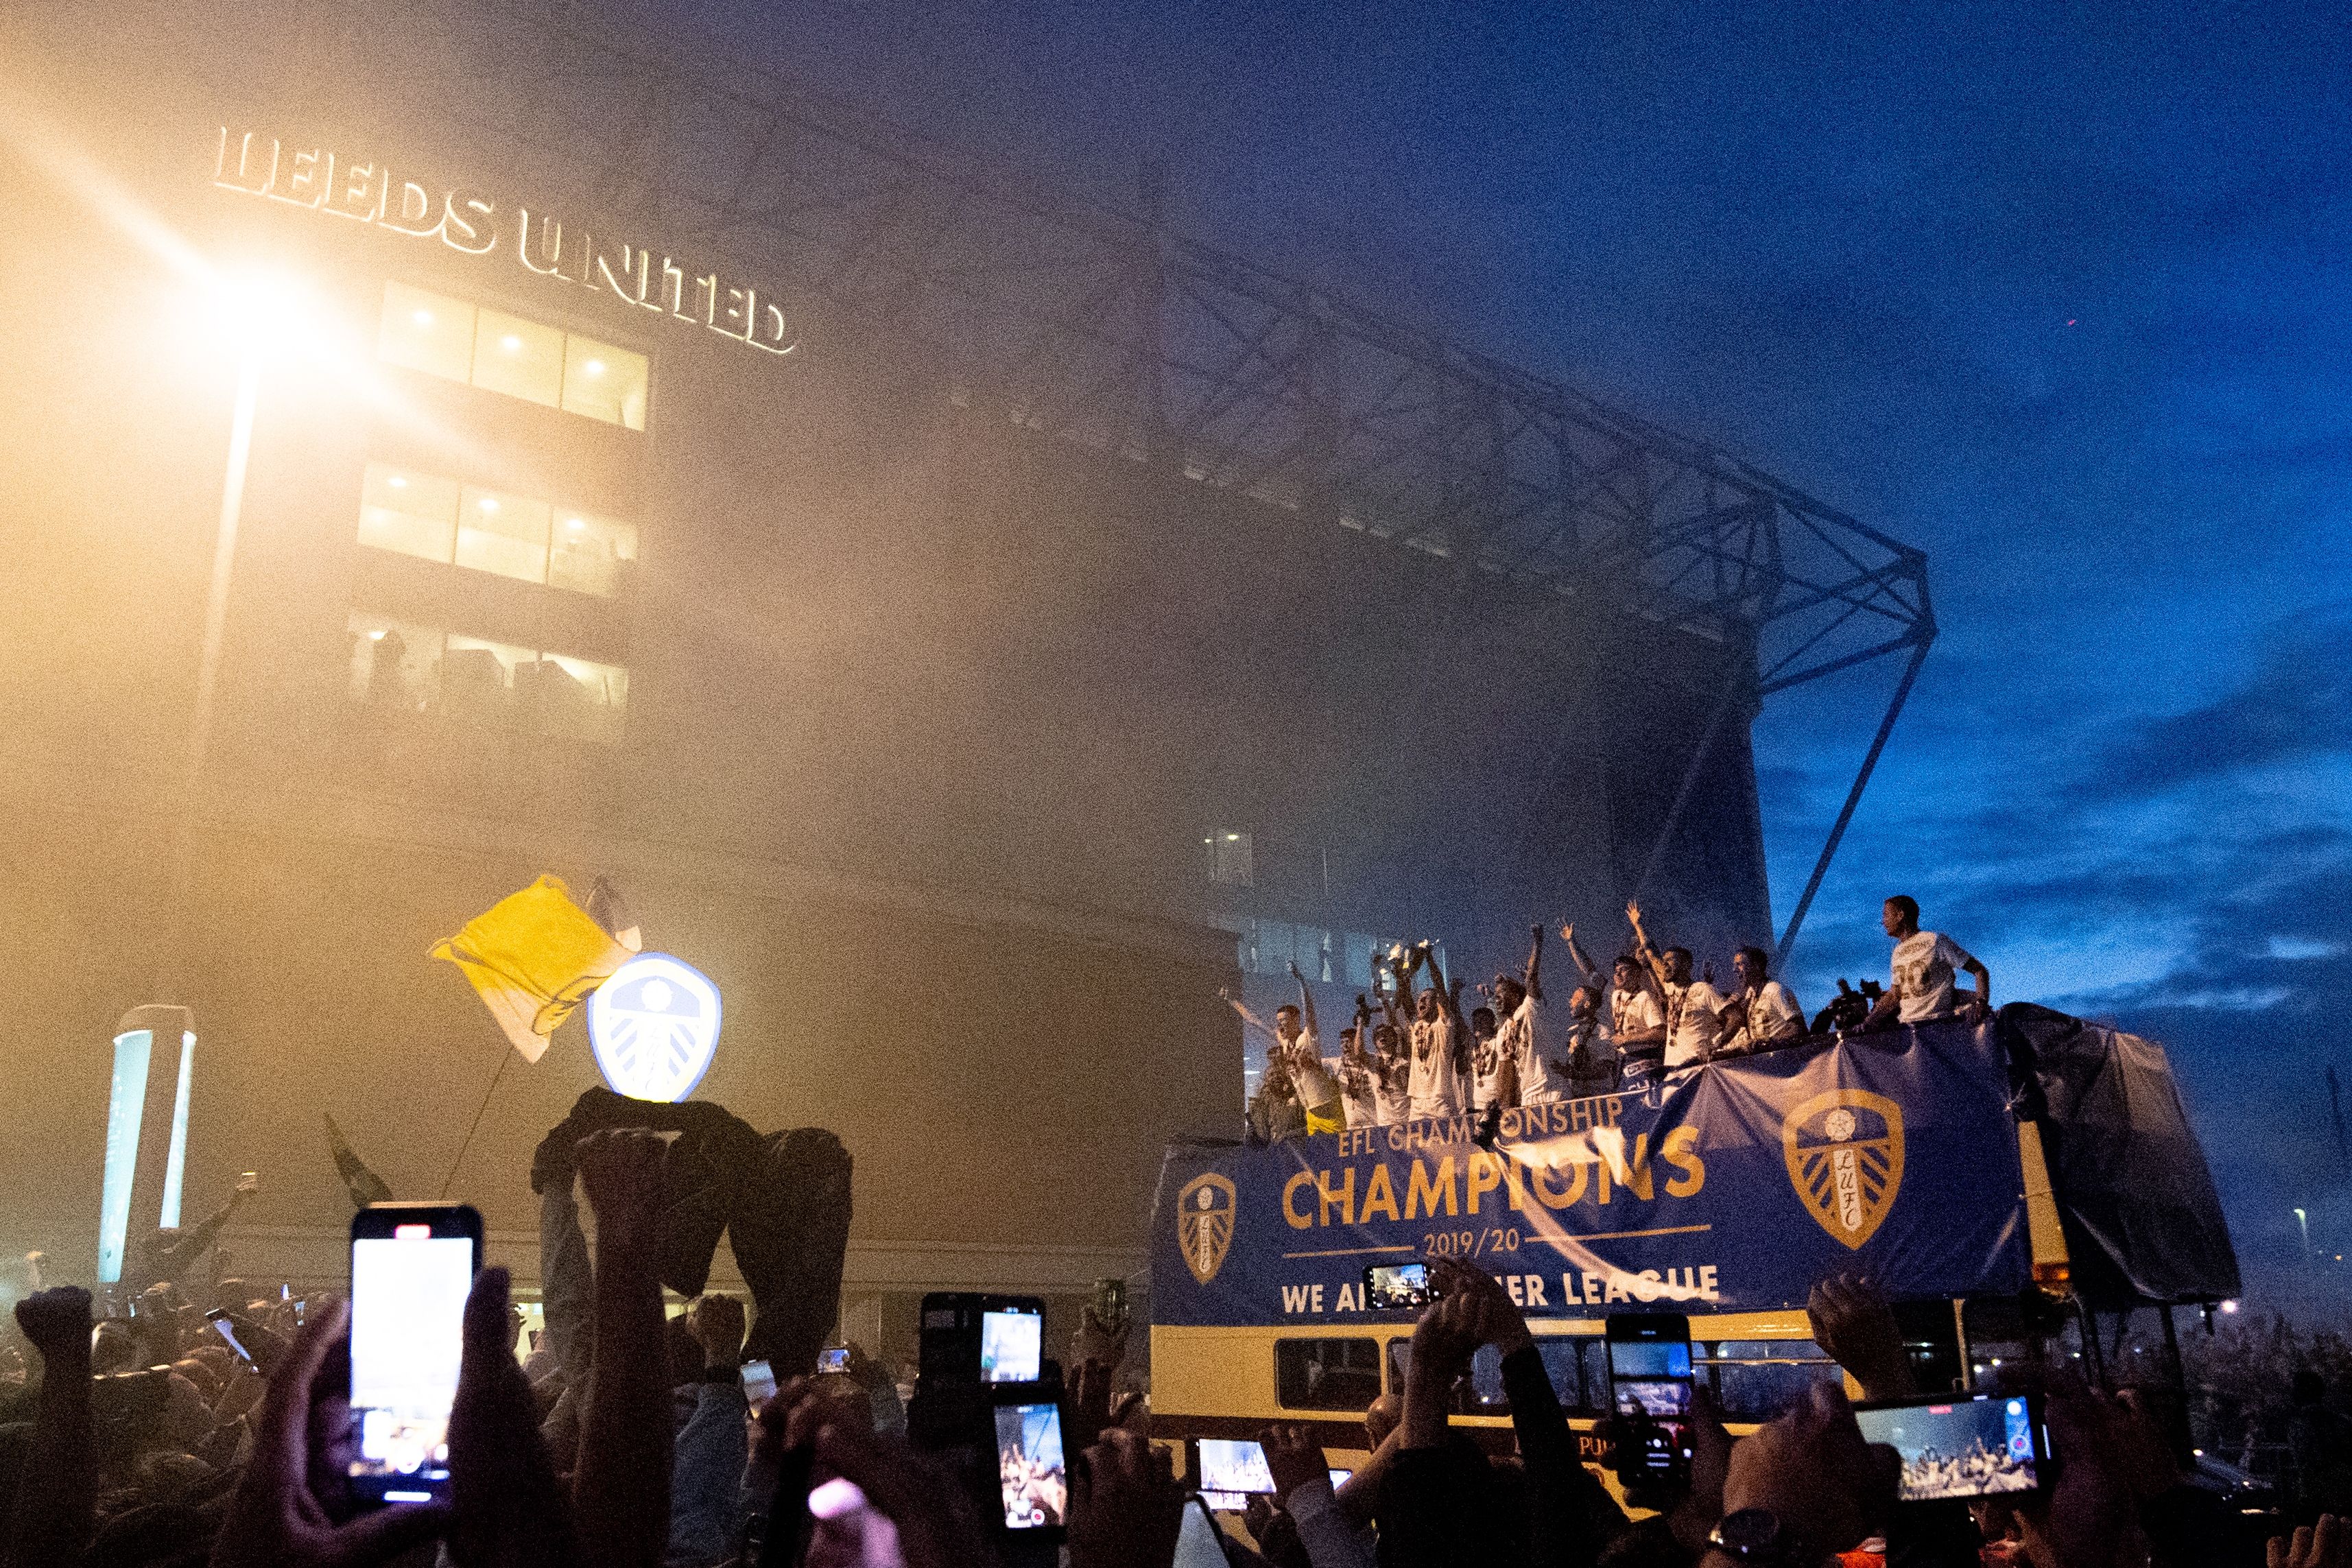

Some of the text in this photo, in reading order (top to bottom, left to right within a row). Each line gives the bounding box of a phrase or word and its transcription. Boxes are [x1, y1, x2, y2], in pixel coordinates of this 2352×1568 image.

[214, 126, 797, 355] LEEDS UNITED
[1338, 1096, 1624, 1158] EFL CHAMONSHIP
[1282, 1125, 1706, 1230] CHAMPIONS
[1836, 1151, 1857, 1226] LUFC
[1423, 1227, 1520, 1259] 2019/20
[1281, 1284, 1324, 1314] WE
[1563, 1265, 1720, 1305] LEAGUE
